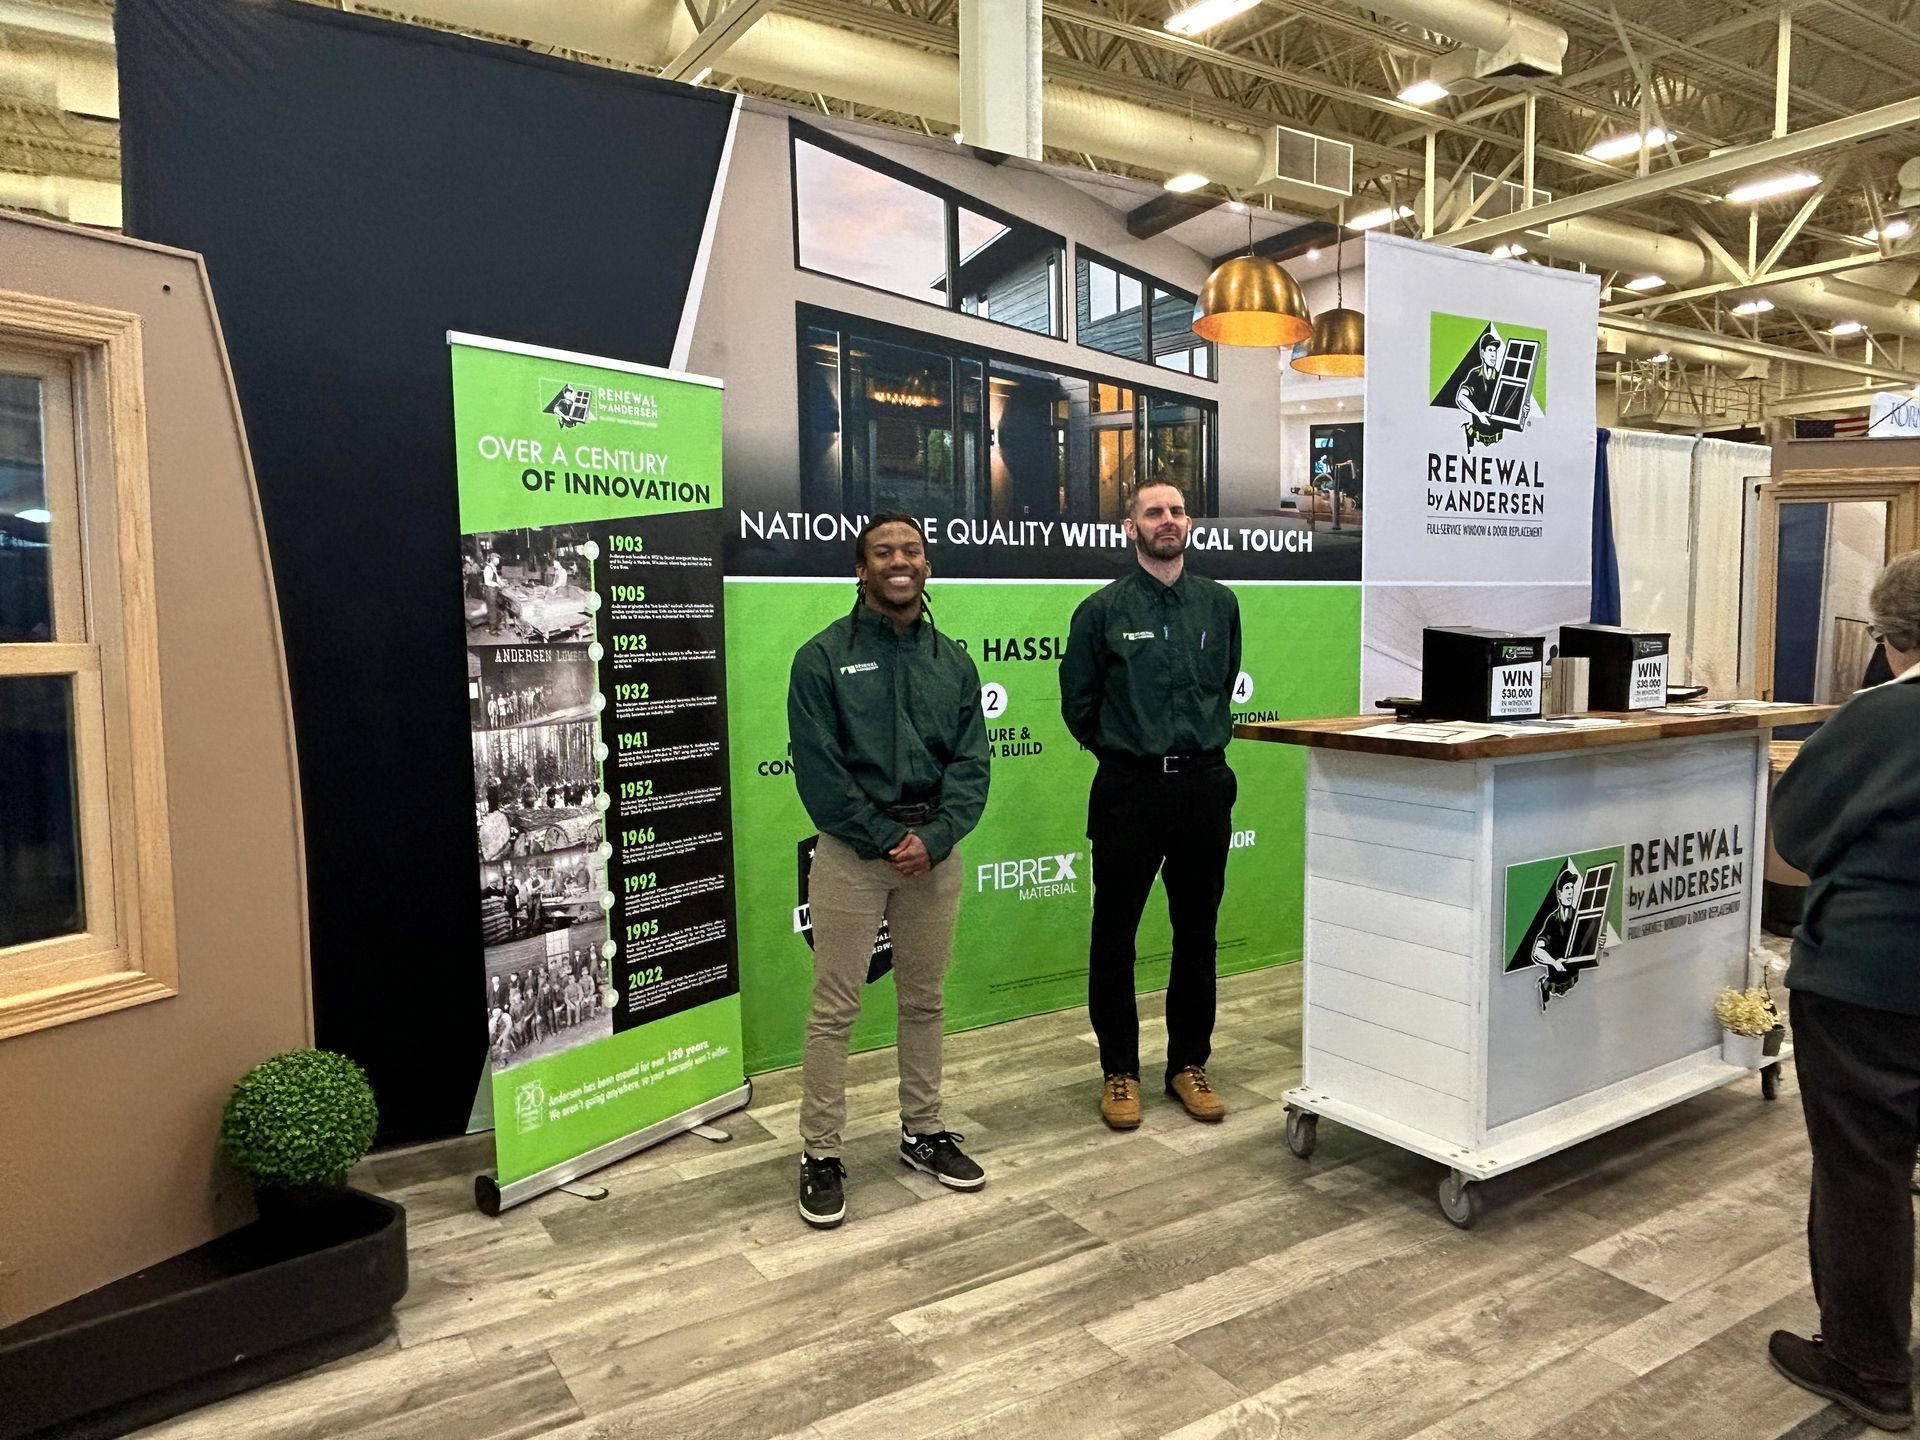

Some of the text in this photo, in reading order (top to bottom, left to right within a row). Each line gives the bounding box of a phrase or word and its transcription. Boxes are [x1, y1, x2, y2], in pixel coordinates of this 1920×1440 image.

[598, 387, 658, 408] RENEWAL
[608, 403, 658, 418] ANDERSEN
[478, 435, 668, 476] OVER A CENTURY
[1428, 452, 1544, 488] RENEWAL
[521, 468, 711, 504] OF INNOVATION
[1427, 488, 1544, 515] by ANDERSEN
[609, 535, 643, 552] 1903
[947, 518, 1054, 546] QUALITY
[1061, 522, 1127, 548] WITH
[1240, 528, 1313, 553] TOUCH
[611, 585, 646, 602] 1905
[613, 634, 647, 651] 1923
[983, 637, 1064, 662] HASSL
[495, 648, 552, 663] ANDERSEN
[1502, 670, 1532, 687] WIN
[1638, 662, 1661, 678] WIN
[615, 682, 649, 700] 1932
[1236, 678, 1246, 697] 4
[1501, 688, 1533, 700] $30,000
[987, 690, 998, 711] 2
[1231, 710, 1280, 724] PTIONAL
[618, 731, 648, 750] 1941
[988, 726, 1031, 742] URE &
[1002, 742, 1043, 757] BUILD
[620, 779, 653, 799] 1952
[622, 827, 655, 847] 1966
[1630, 824, 1743, 878] RENEWAL
[978, 852, 1077, 893] FIBREX
[624, 872, 657, 893] 1992
[1019, 882, 1078, 901] MATERIAL
[1629, 862, 1742, 911] by ANDERSEN
[626, 919, 659, 941] 1995
[629, 965, 663, 990] 2022
[668, 1047, 684, 1062] 120
